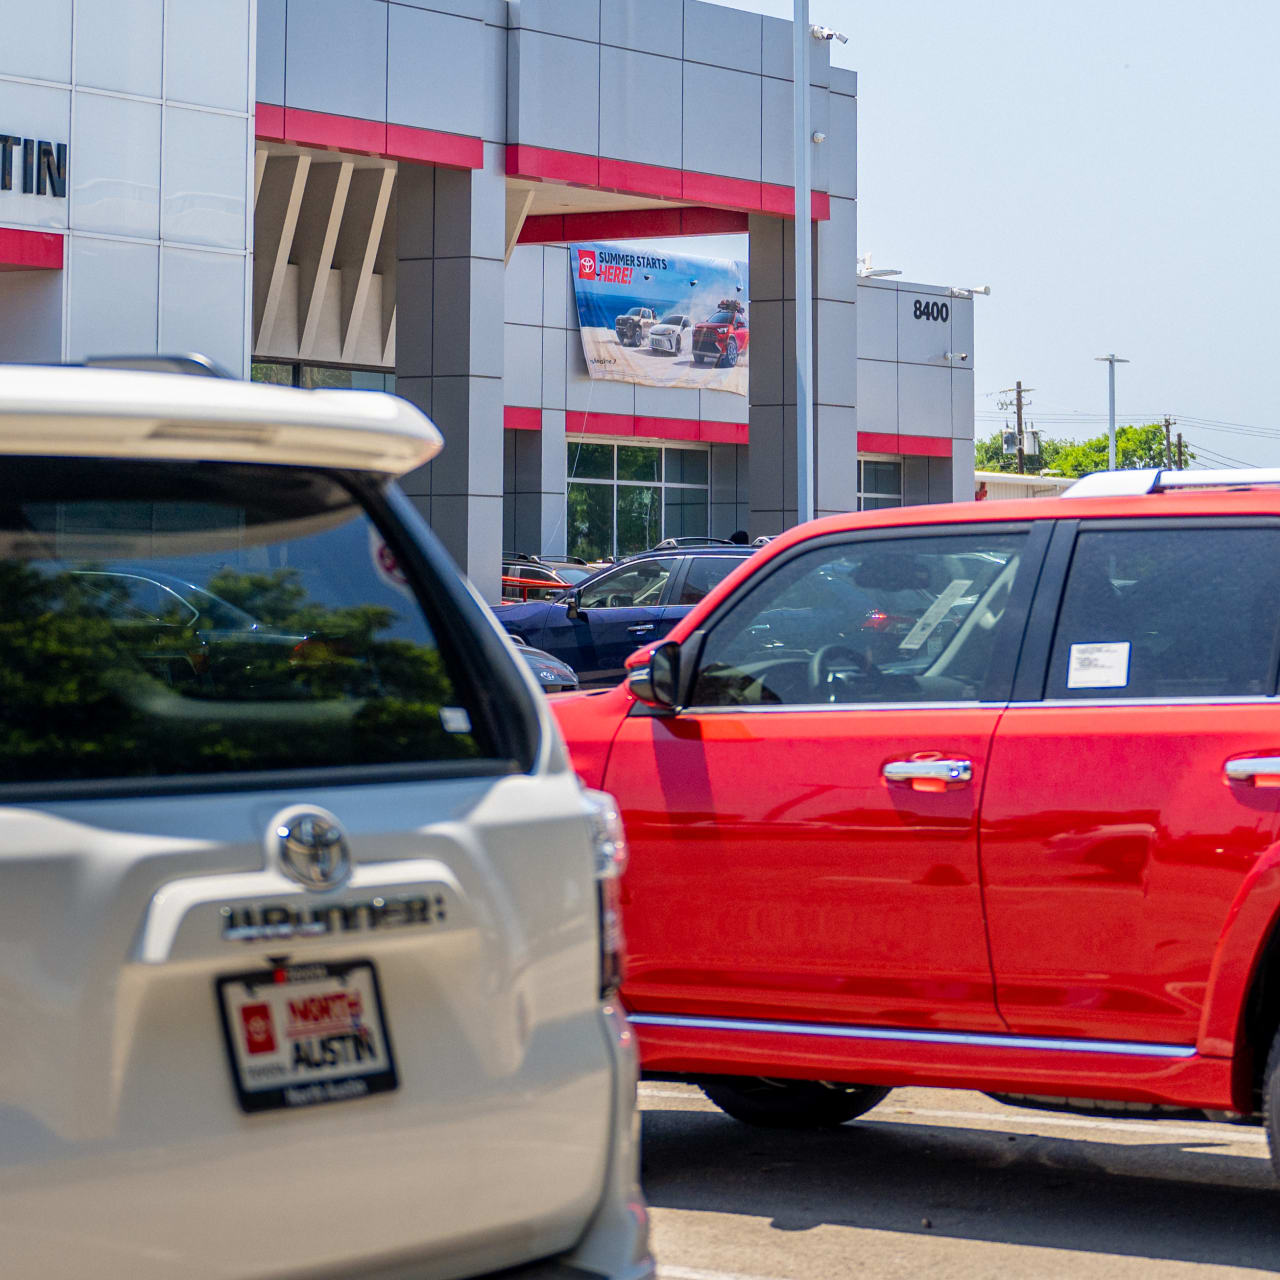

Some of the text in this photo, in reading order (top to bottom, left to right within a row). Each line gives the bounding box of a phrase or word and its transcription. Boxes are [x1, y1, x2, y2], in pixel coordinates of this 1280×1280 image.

[599, 251, 668, 270] SUMMER STARTS
[598, 264, 633, 285] HERE!
[913, 299, 950, 323] 8400
[287, 990, 364, 1023] NORTH
[292, 1032, 377, 1071] AUSTIN
